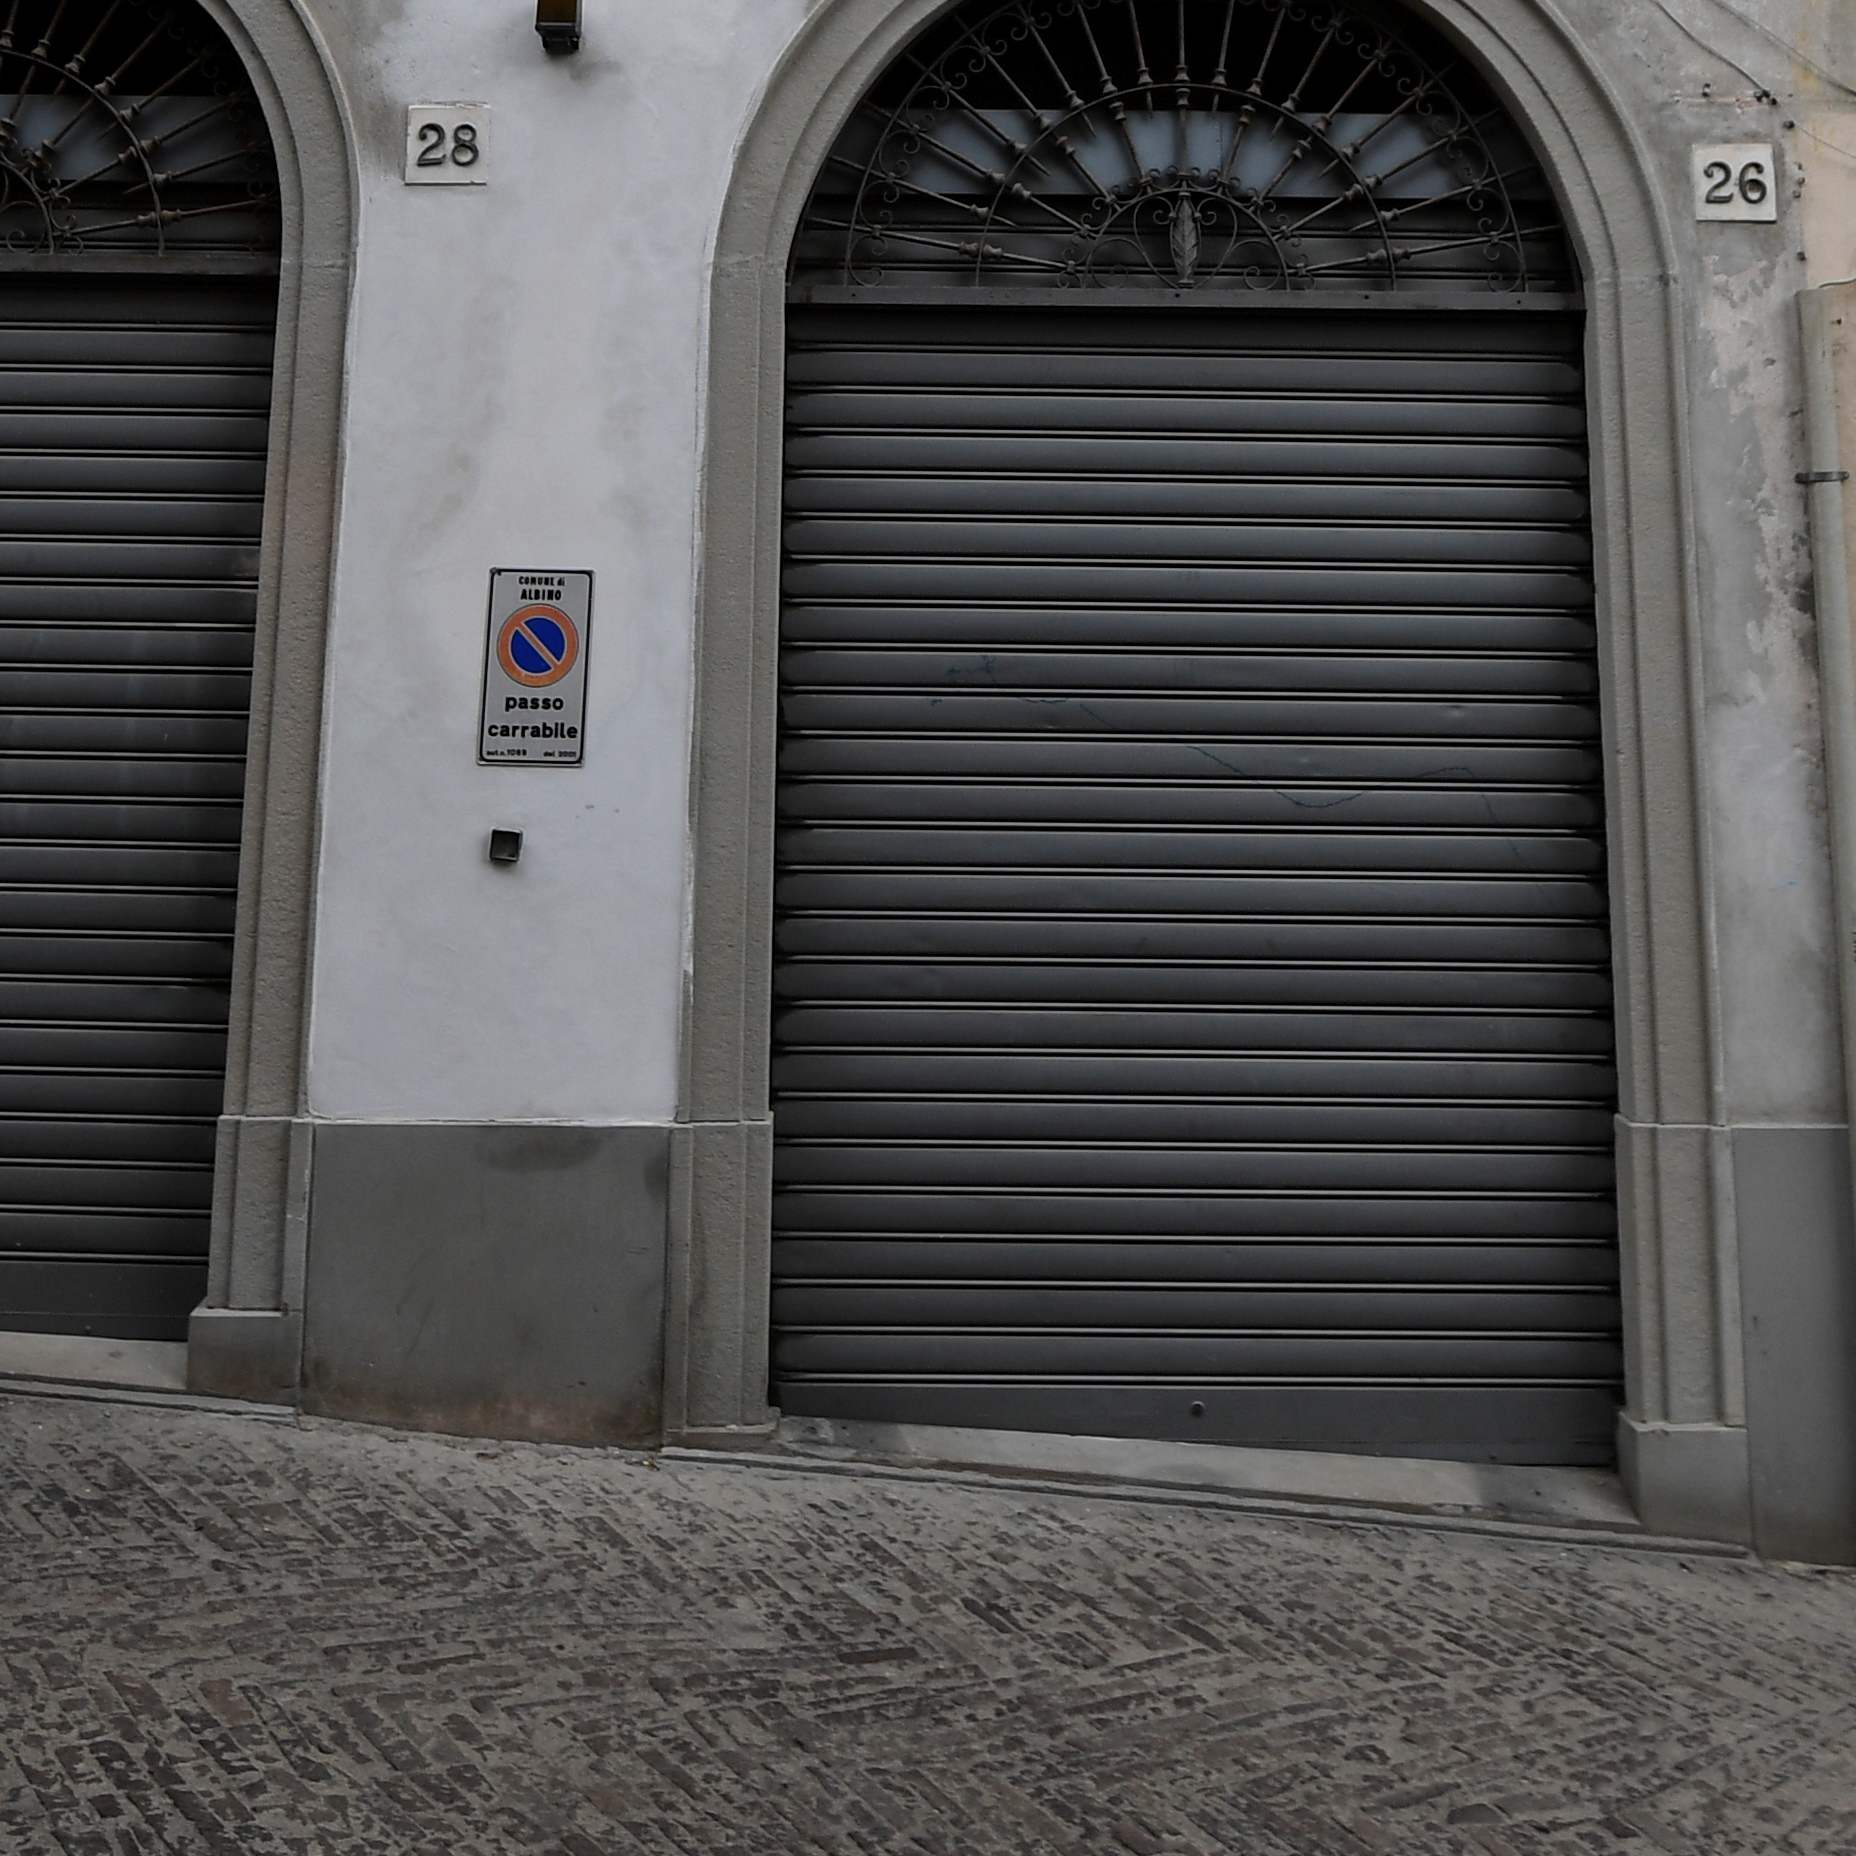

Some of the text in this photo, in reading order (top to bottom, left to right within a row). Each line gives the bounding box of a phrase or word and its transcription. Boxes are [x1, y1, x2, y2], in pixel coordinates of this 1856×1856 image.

[416, 123, 480, 168] 28
[1703, 161, 1767, 204] 26
[518, 575, 565, 586] COMUNE di
[520, 588, 562, 601] ALBINO
[505, 696, 564, 712] passo
[487, 722, 578, 739] carrabile
